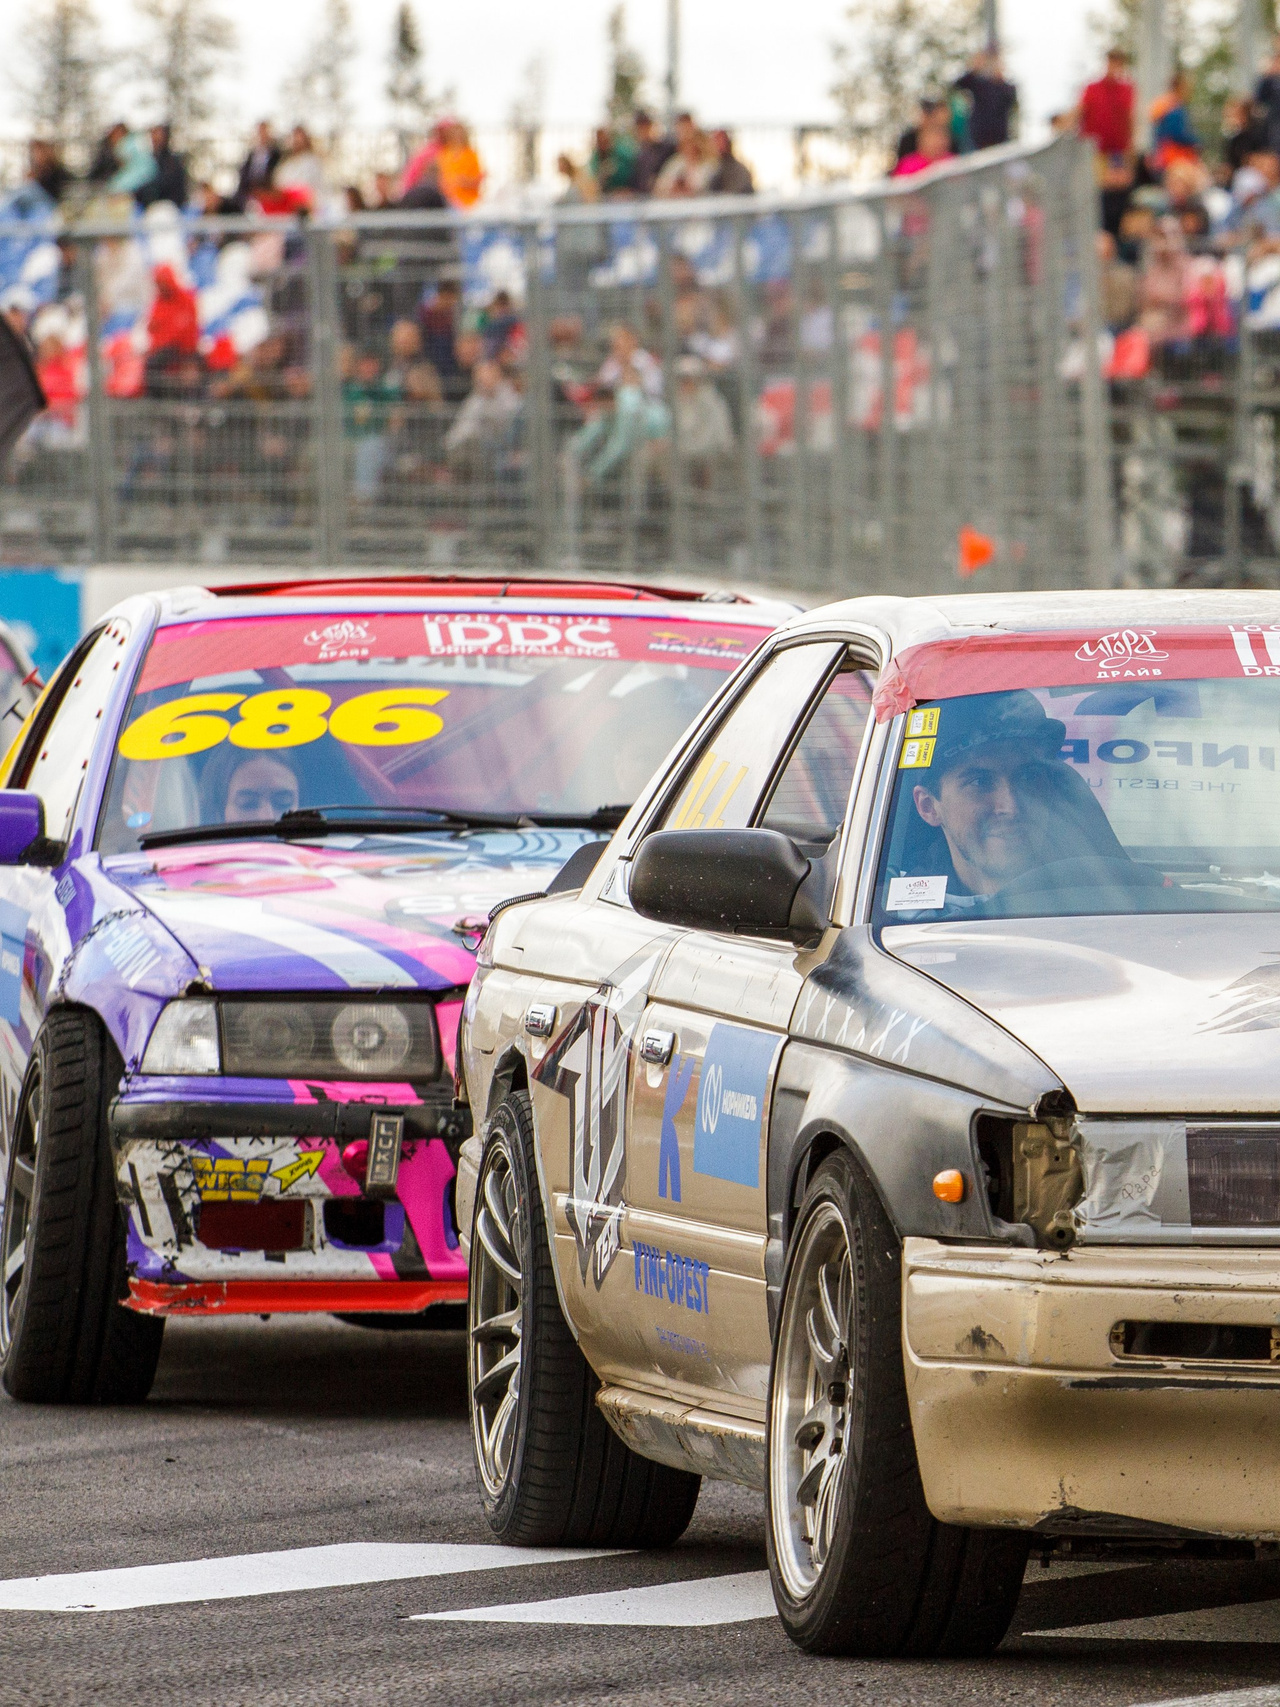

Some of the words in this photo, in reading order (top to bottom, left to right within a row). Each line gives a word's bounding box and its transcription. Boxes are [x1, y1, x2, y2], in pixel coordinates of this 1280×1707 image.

[423, 621, 616, 650] IDDC
[1096, 668, 1163, 680] ДРАЙВ
[118, 688, 451, 761] 686
